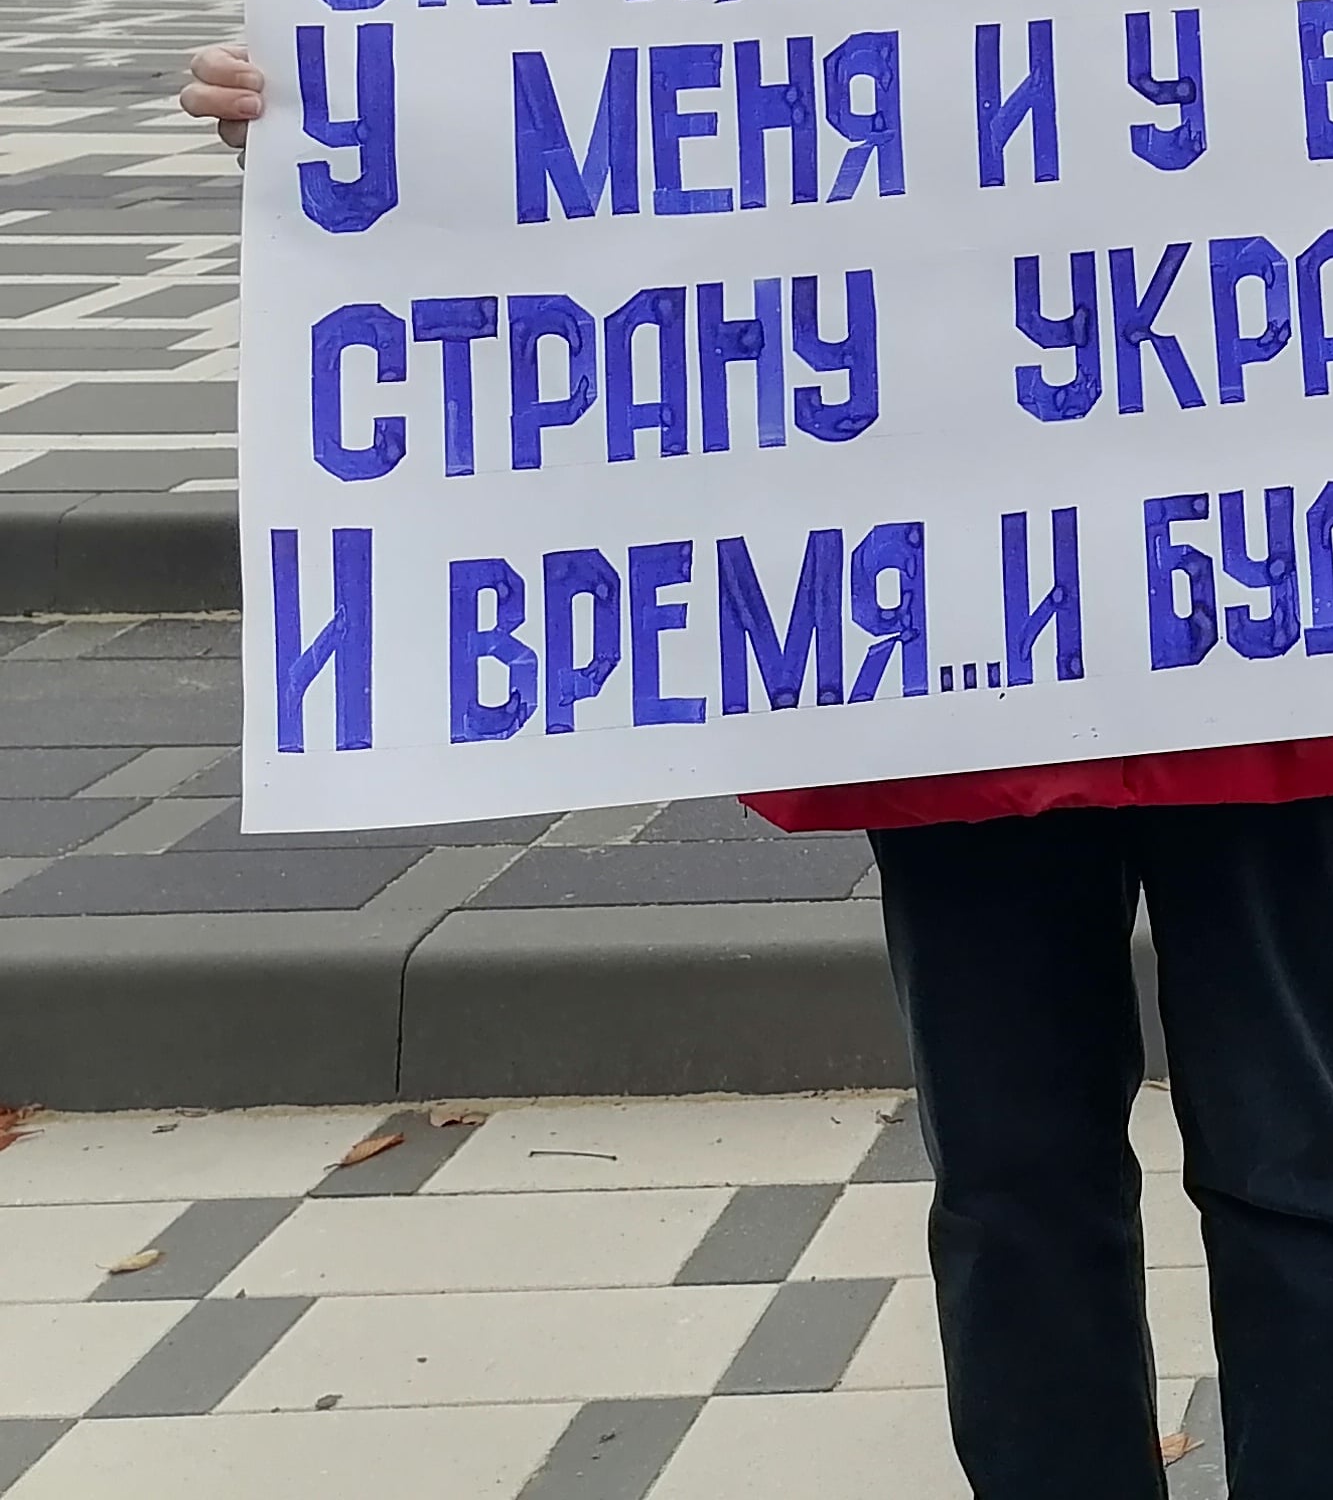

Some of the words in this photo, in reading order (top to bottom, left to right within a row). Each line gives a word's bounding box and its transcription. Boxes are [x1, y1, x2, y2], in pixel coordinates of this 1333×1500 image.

[296, 22, 399, 234] У
[512, 30, 907, 225] МЕНЯ
[975, 19, 1060, 188] И
[1125, 8, 1207, 172] У
[311, 269, 880, 482] СТРАНУ
[270, 528, 373, 754] И
